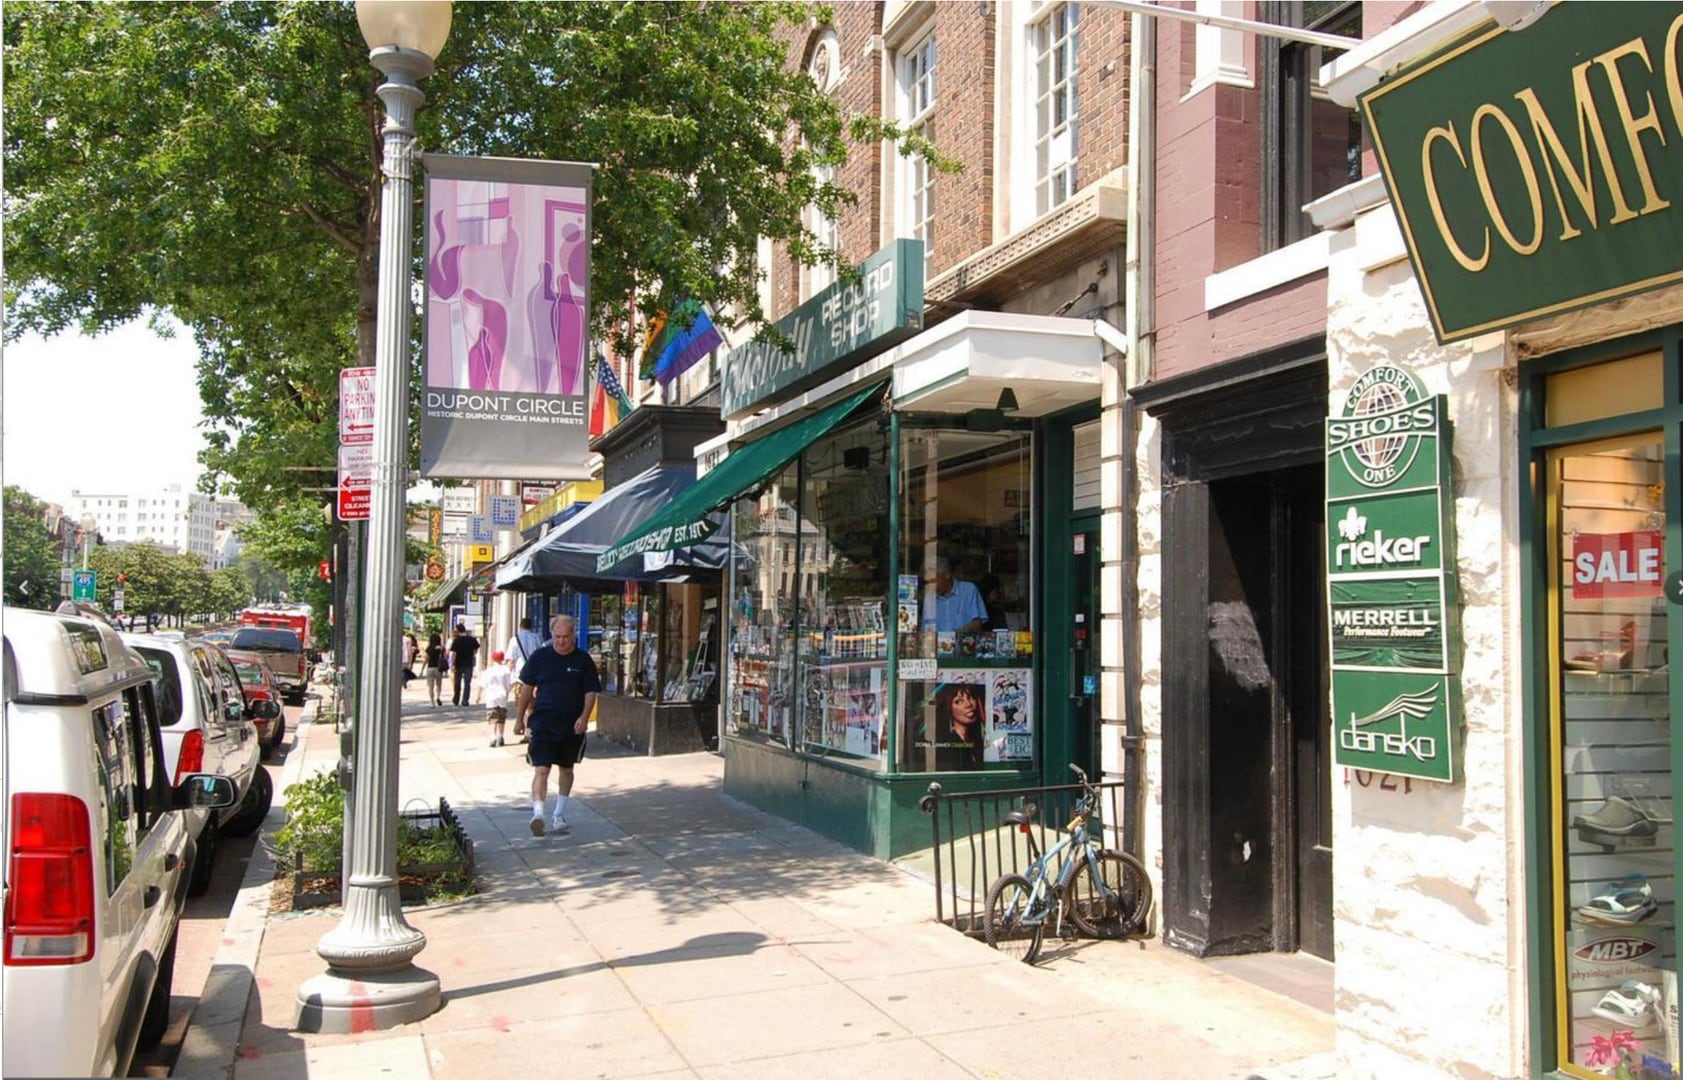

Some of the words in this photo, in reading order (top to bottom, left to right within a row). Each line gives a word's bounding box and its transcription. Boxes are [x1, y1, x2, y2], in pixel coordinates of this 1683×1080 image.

[1422, 11, 1683, 272] COMF
[831, 300, 880, 347] SHOP
[357, 378, 369, 391] NO
[1347, 368, 1414, 408] COMFORT
[345, 392, 375, 406] PARKIN
[427, 393, 511, 412] DUPONT
[516, 398, 585, 416] CIRCLE
[428, 410, 463, 418] HISTORIC
[465, 412, 498, 420] DUPONT
[500, 414, 527, 422] CIRCLE
[529, 415, 549, 423] MAIN
[551, 417, 584, 425] STREETS
[1328, 405, 1435, 445] SHOES
[1364, 464, 1396, 482] ONE
[1335, 530, 1430, 566] rieker
[1575, 548, 1659, 584] SALE
[1333, 609, 1438, 626] MERRELL
[1344, 626, 1390, 637] Performance
[1340, 712, 1435, 761] dansko
[1588, 941, 1643, 961] MBT
